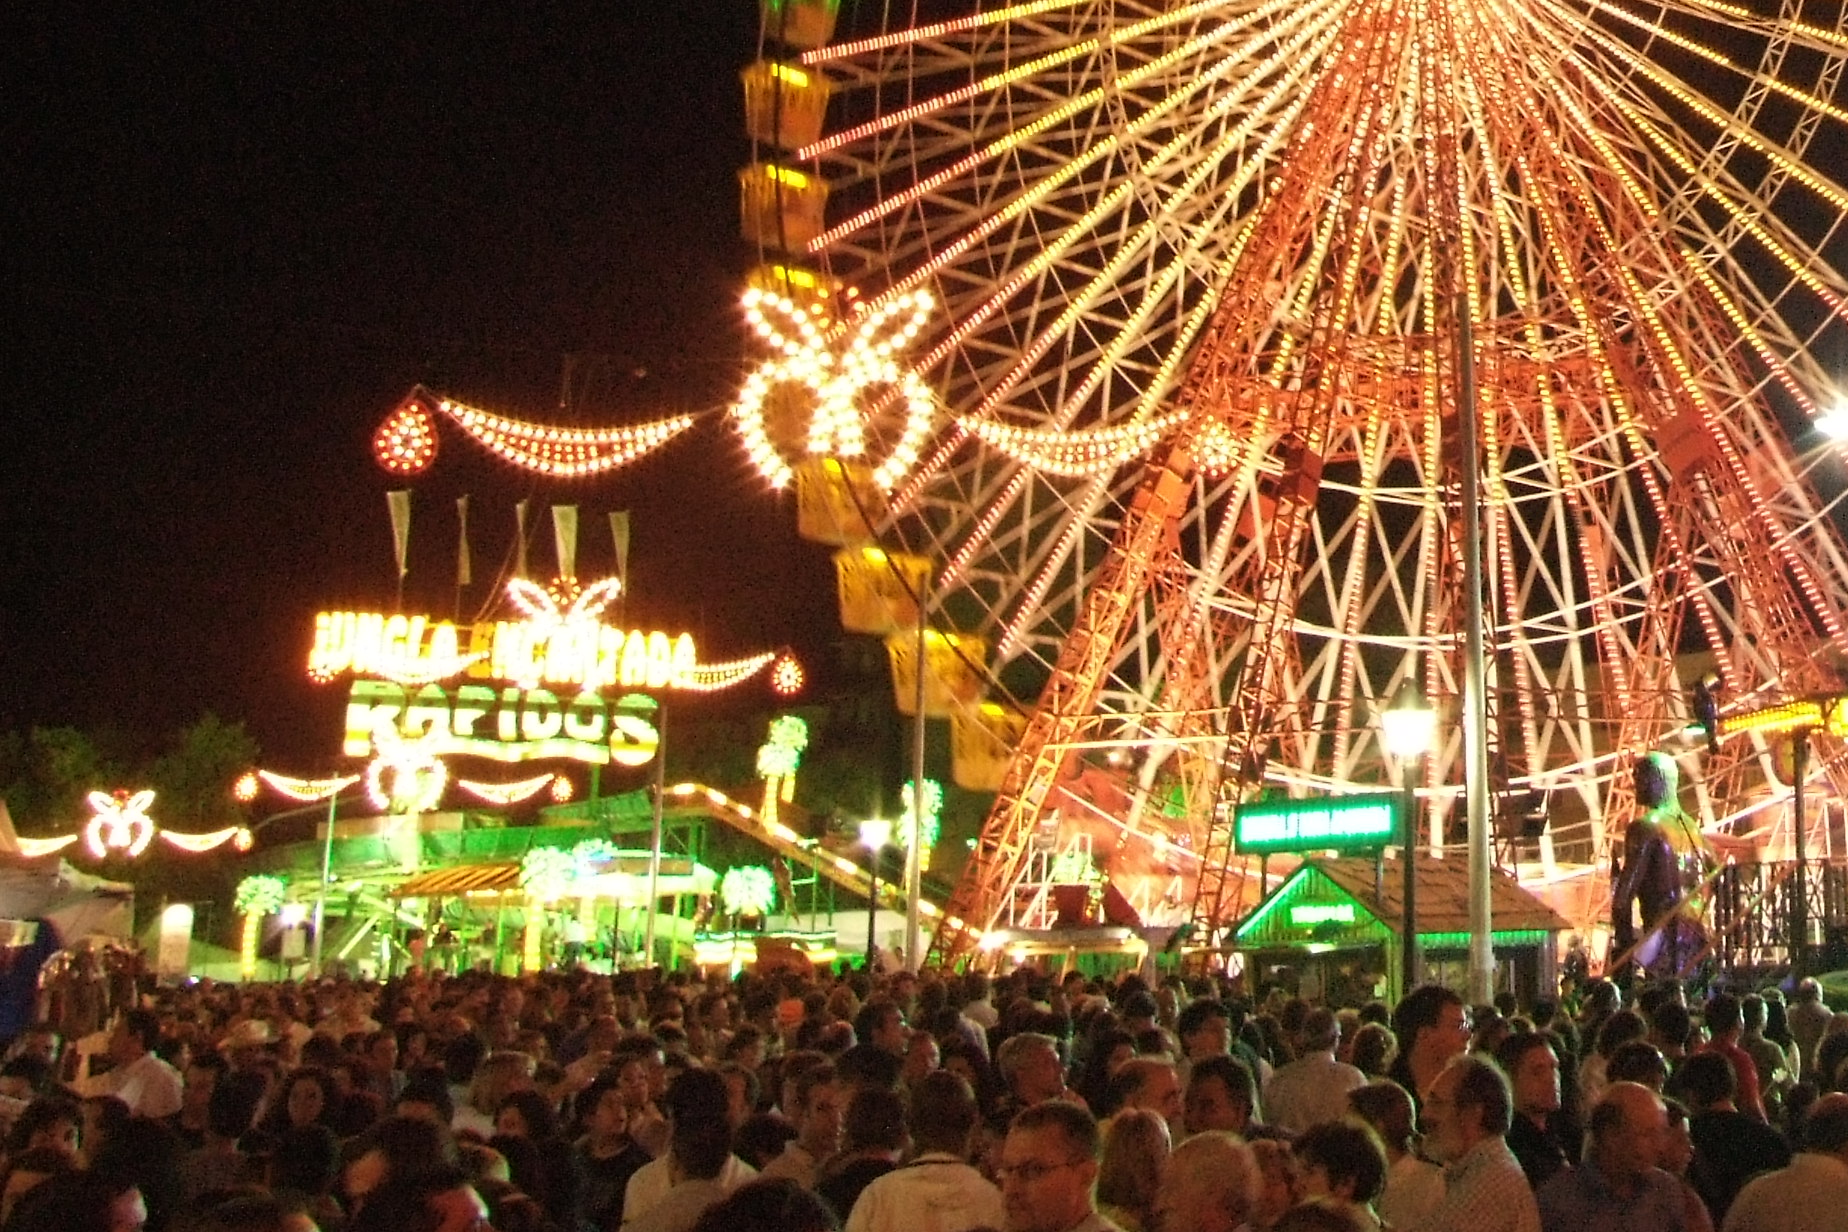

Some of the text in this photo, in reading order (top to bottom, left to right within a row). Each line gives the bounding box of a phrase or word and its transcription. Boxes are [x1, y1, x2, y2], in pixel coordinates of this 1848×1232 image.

[306, 611, 697, 687] JUNGLA ENCANTADA
[343, 679, 660, 766] RAPIDOS
